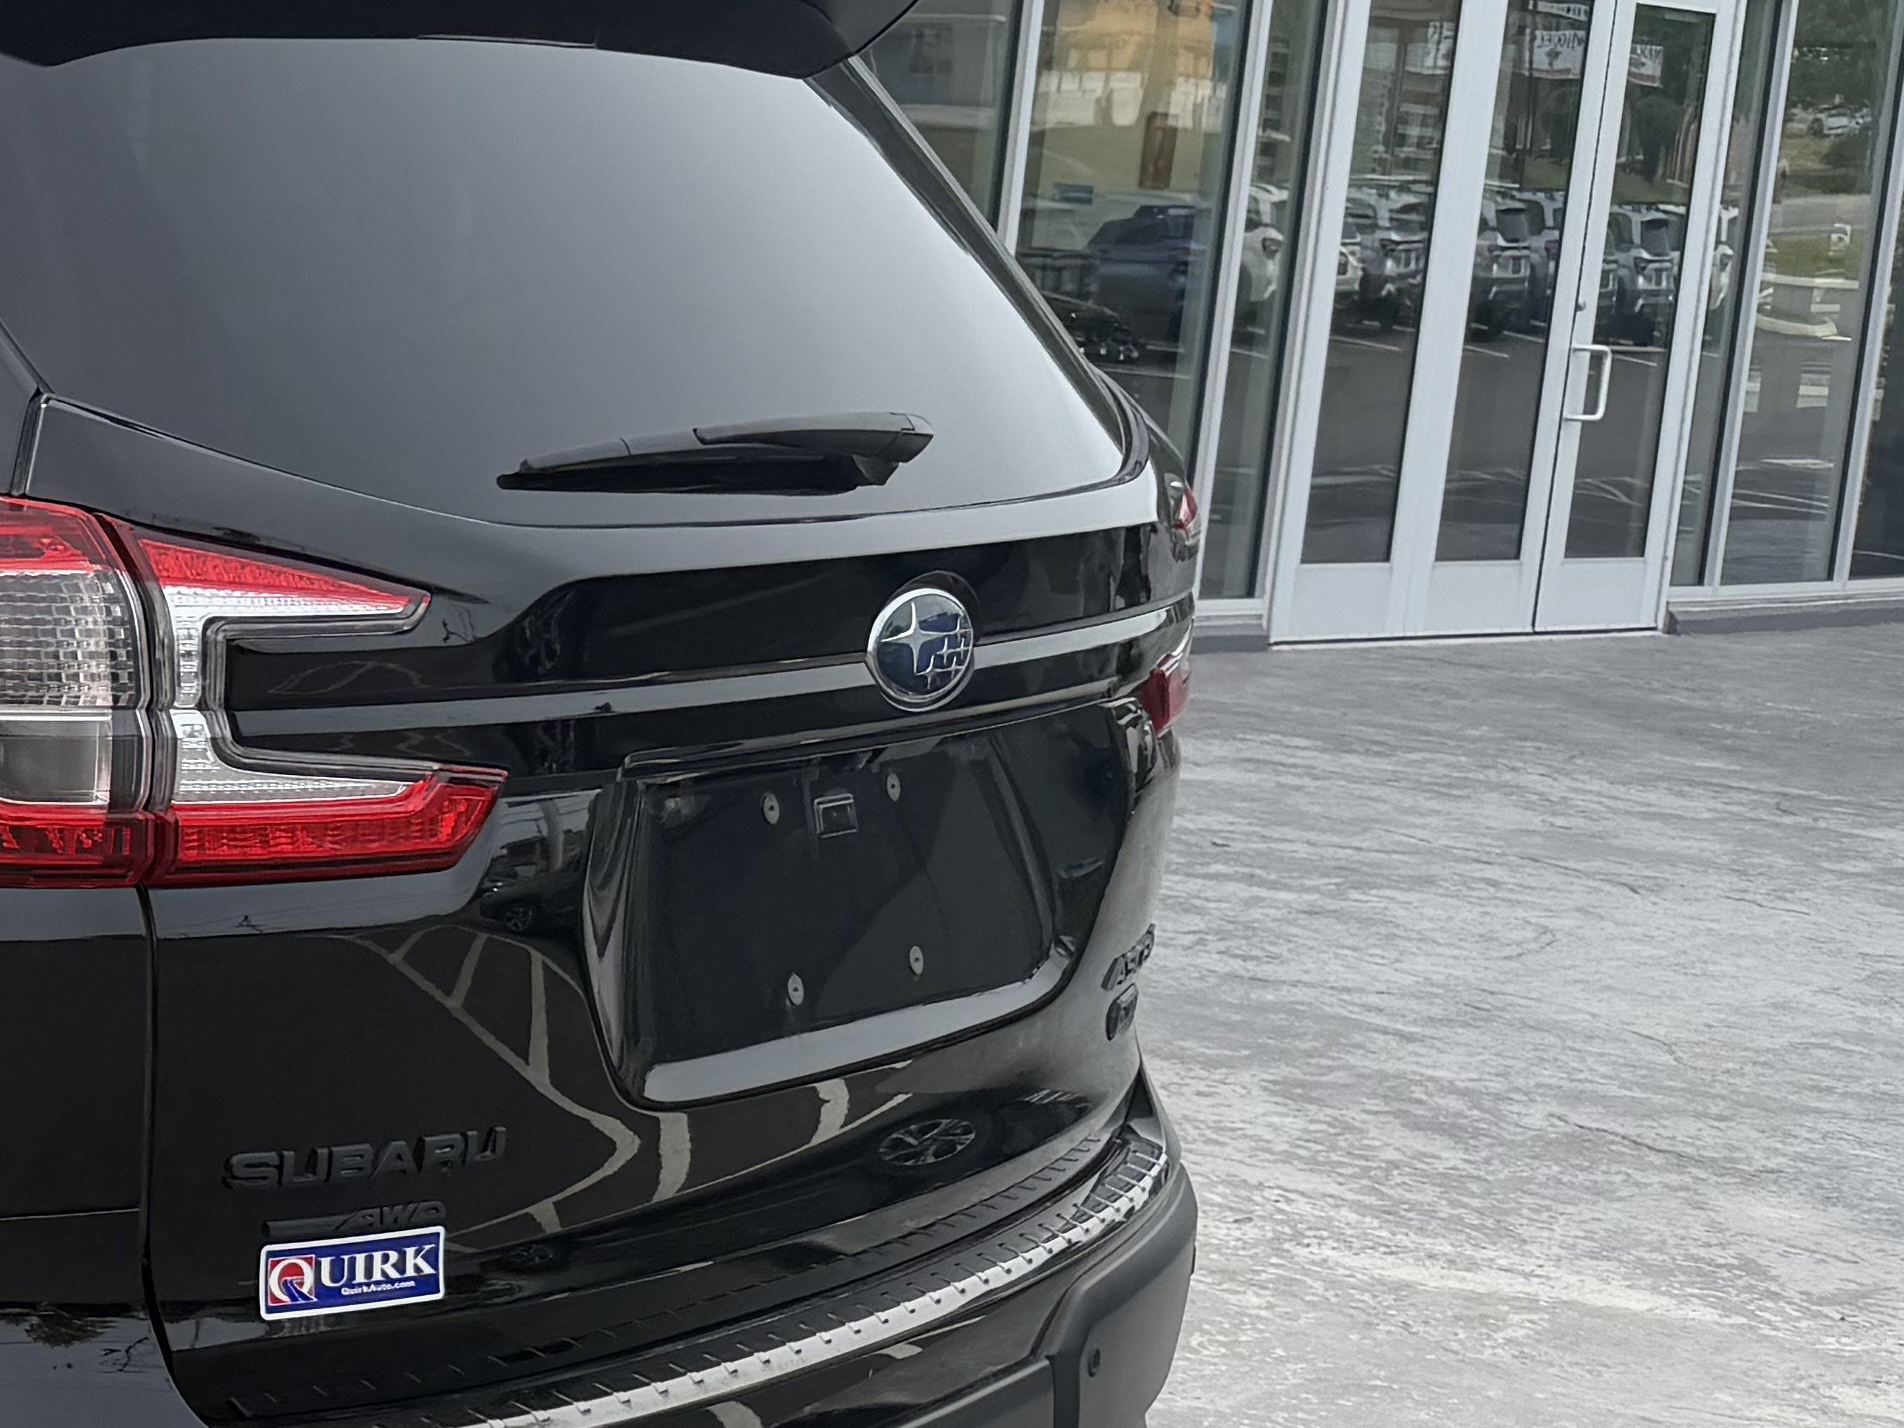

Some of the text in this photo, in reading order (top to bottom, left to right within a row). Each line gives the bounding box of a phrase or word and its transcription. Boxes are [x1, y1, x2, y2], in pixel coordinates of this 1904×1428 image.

[222, 1126, 506, 1189] SUBARU
[339, 1201, 445, 1230] AWD
[269, 1245, 437, 1305] QUIRK
[341, 1280, 415, 1297] QuirkAuto.com
